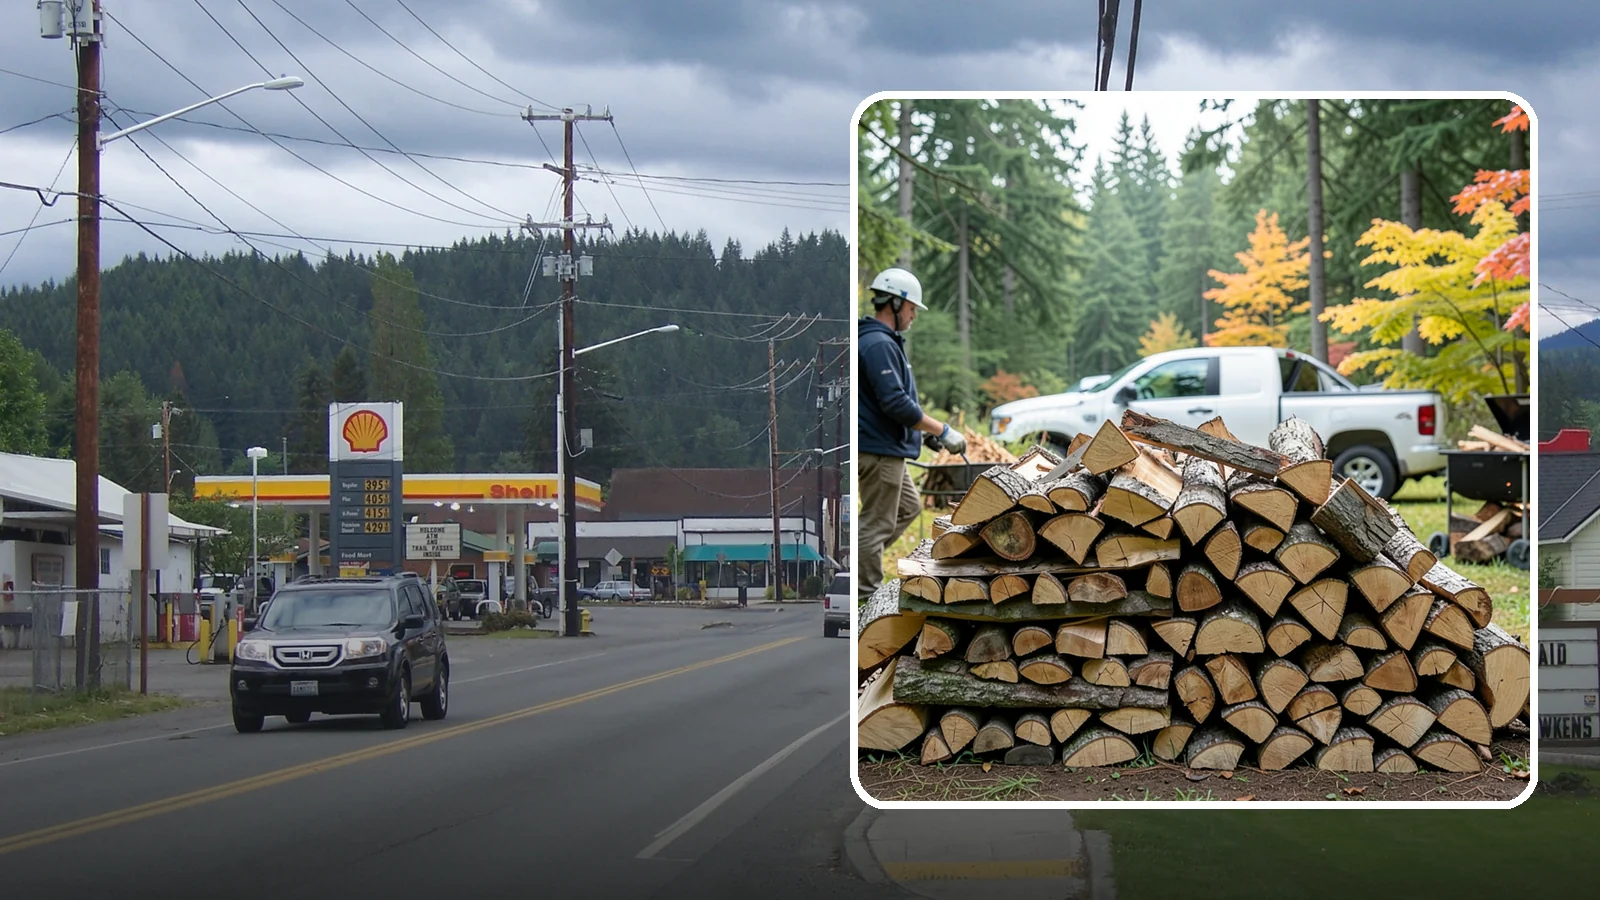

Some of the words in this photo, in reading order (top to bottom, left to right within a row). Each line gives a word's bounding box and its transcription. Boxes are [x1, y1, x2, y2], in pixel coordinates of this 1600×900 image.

[366, 480, 383, 490] 395
[490, 484, 547, 499] Shell
[366, 494, 383, 504] 405
[366, 508, 383, 518] 415
[366, 522, 383, 532] 429
